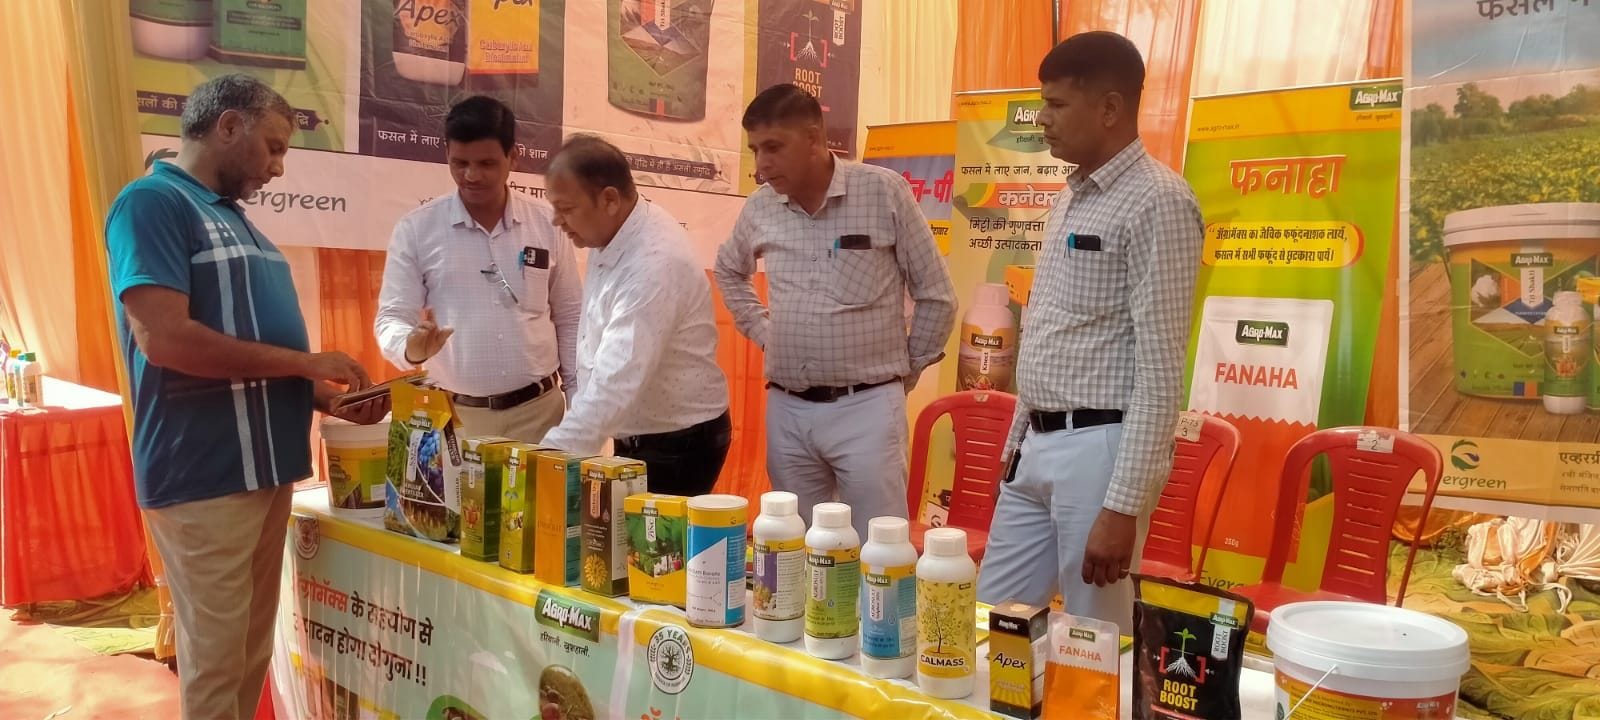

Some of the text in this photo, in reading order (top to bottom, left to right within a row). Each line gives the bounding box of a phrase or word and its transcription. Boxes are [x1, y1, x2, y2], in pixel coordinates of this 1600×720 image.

[794, 67, 822, 85] ROOT
[378, 129, 441, 149] फसल में लाए
[529, 148, 548, 160] शान
[961, 165, 982, 176] फसल
[994, 164, 1011, 177] लाए
[1013, 165, 1032, 177] जान,
[1229, 154, 1347, 200] फनाहा
[992, 217, 1006, 231] की
[1008, 220, 1045, 235] गुणवत्ता
[1249, 229, 1258, 240] का
[1260, 226, 1282, 240] जैविक
[969, 236, 1042, 251] अच्छी उत्पादकता
[1215, 249, 1233, 261] फसल
[1243, 247, 1256, 260] सभी
[1279, 247, 1286, 261] से
[1286, 250, 1315, 265] छुटकारा
[1241, 324, 1284, 342] AGRO-MAX
[1214, 362, 1299, 390] FANAHA
[1370, 439, 1378, 451] 2
[350, 590, 366, 619] के
[418, 617, 434, 646] से
[541, 597, 592, 631] AGRO-MAX
[336, 627, 366, 661] होगा
[368, 641, 413, 682] दोगुना
[920, 653, 965, 667] CALMASS
[993, 652, 1027, 670] Apex
[1059, 645, 1102, 662] FANAHA
[1163, 678, 1197, 697] ROOT
[1159, 690, 1199, 711] BOOST
